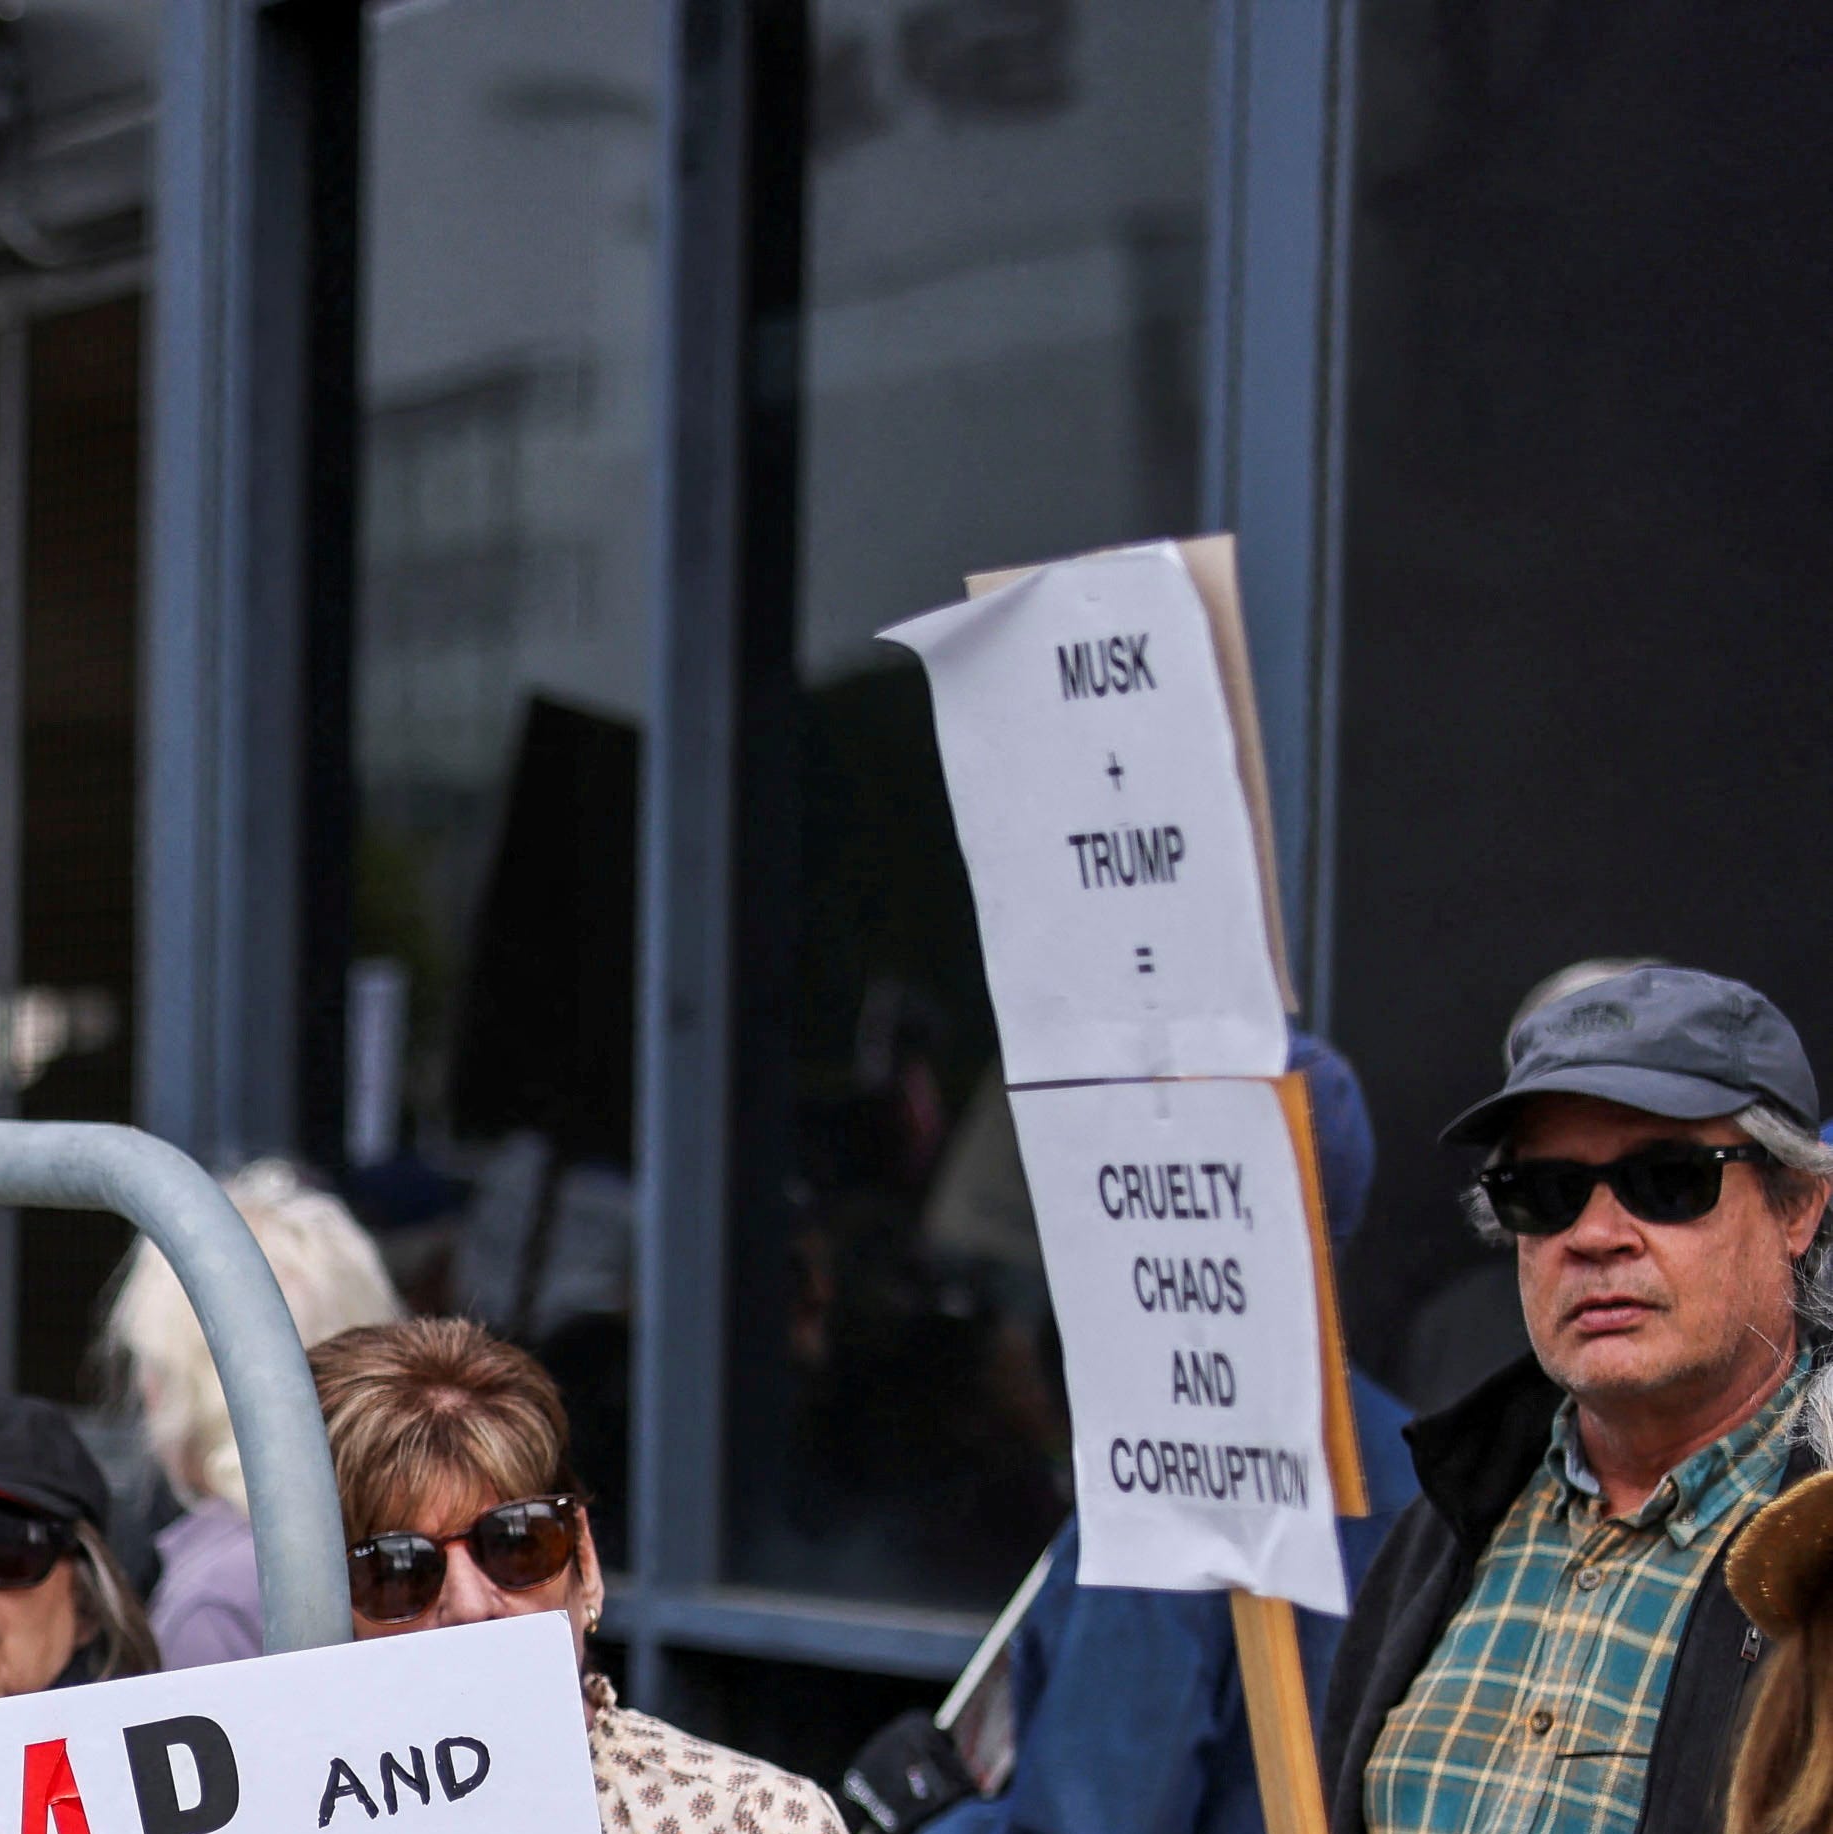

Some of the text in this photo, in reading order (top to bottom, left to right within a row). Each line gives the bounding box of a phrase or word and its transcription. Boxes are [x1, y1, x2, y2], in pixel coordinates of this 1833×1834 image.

[1057, 632, 1158, 701] MUSK
[1107, 751, 1124, 791] +
[1067, 826, 1185, 889] TRUMP
[1098, 1163, 1253, 1232] CRUELTY,
[1133, 1256, 1246, 1315] CHAOS
[1172, 1350, 1235, 1408] AND
[1110, 1437, 1309, 1510] CORRUPTION
[318, 1735, 491, 1829] AND
